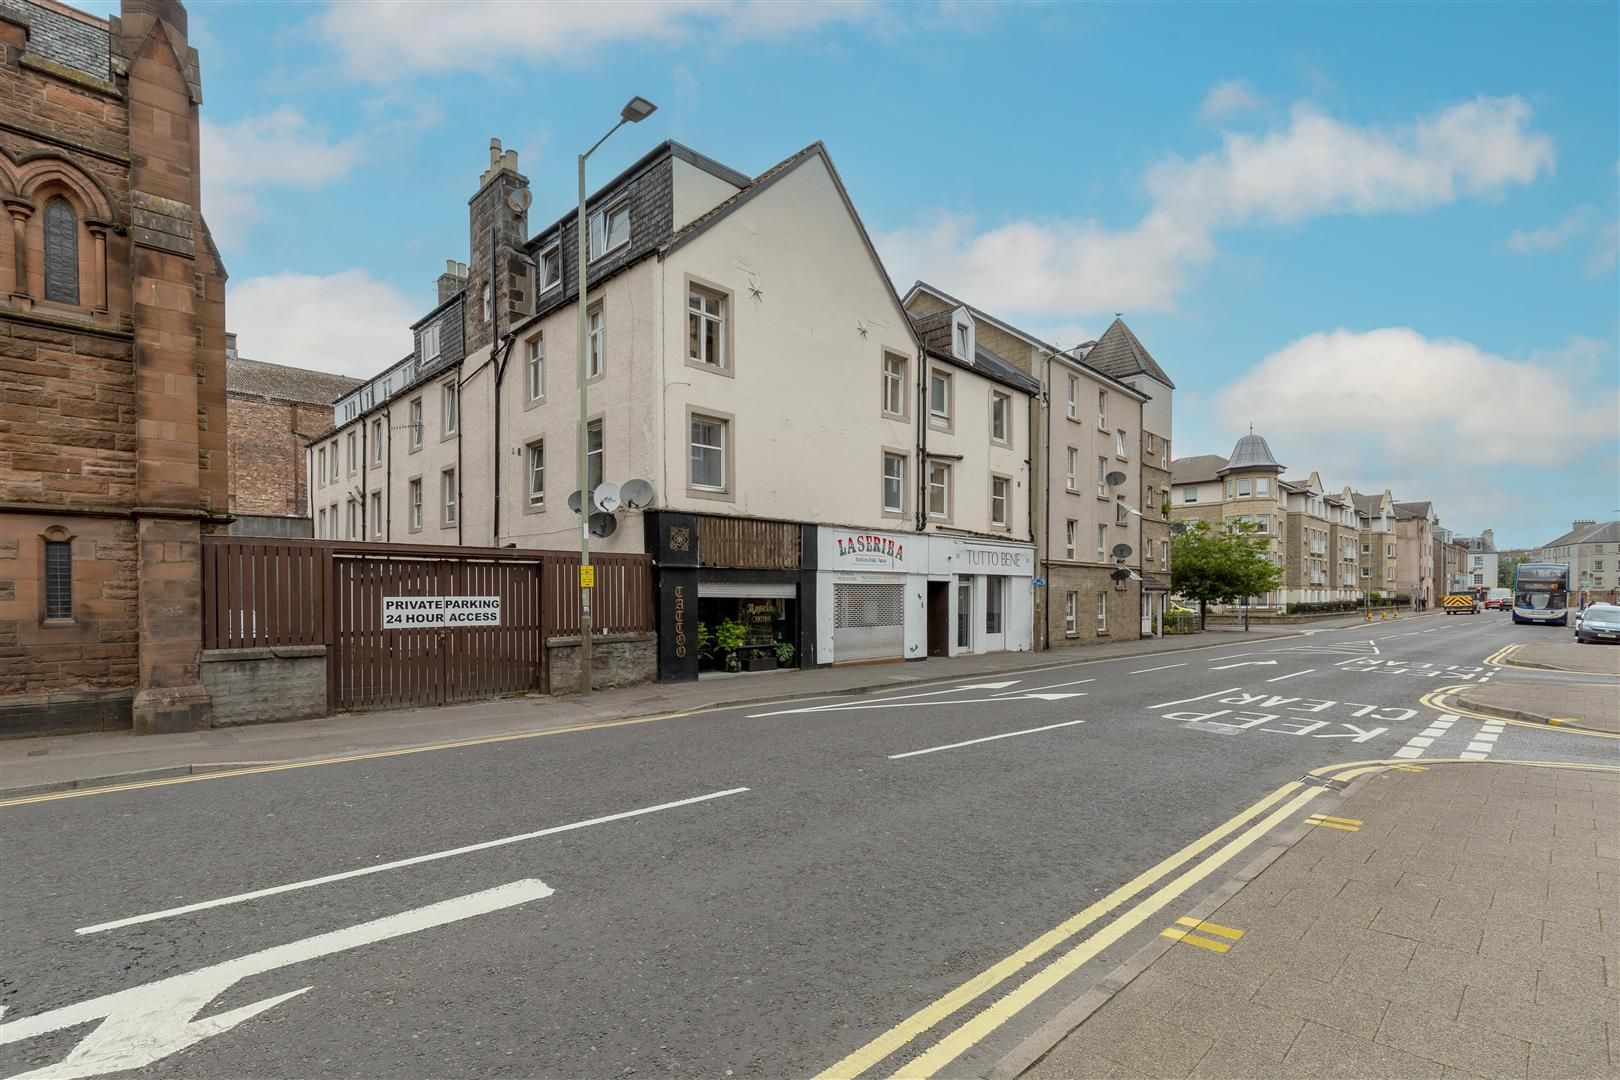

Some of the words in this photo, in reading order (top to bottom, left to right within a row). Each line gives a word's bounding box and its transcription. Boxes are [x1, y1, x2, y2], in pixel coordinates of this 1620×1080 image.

[966, 549, 999, 567] TUTTO
[1000, 552, 1021, 568] BENE
[386, 600, 443, 610] PRIVATE
[445, 600, 499, 609] PARKING
[386, 614, 403, 624] 24
[406, 613, 444, 623] HOUR
[449, 612, 497, 622] ACCESS
[1218, 693, 1418, 721] CLEAR
[1161, 709, 1389, 743] KEEP
